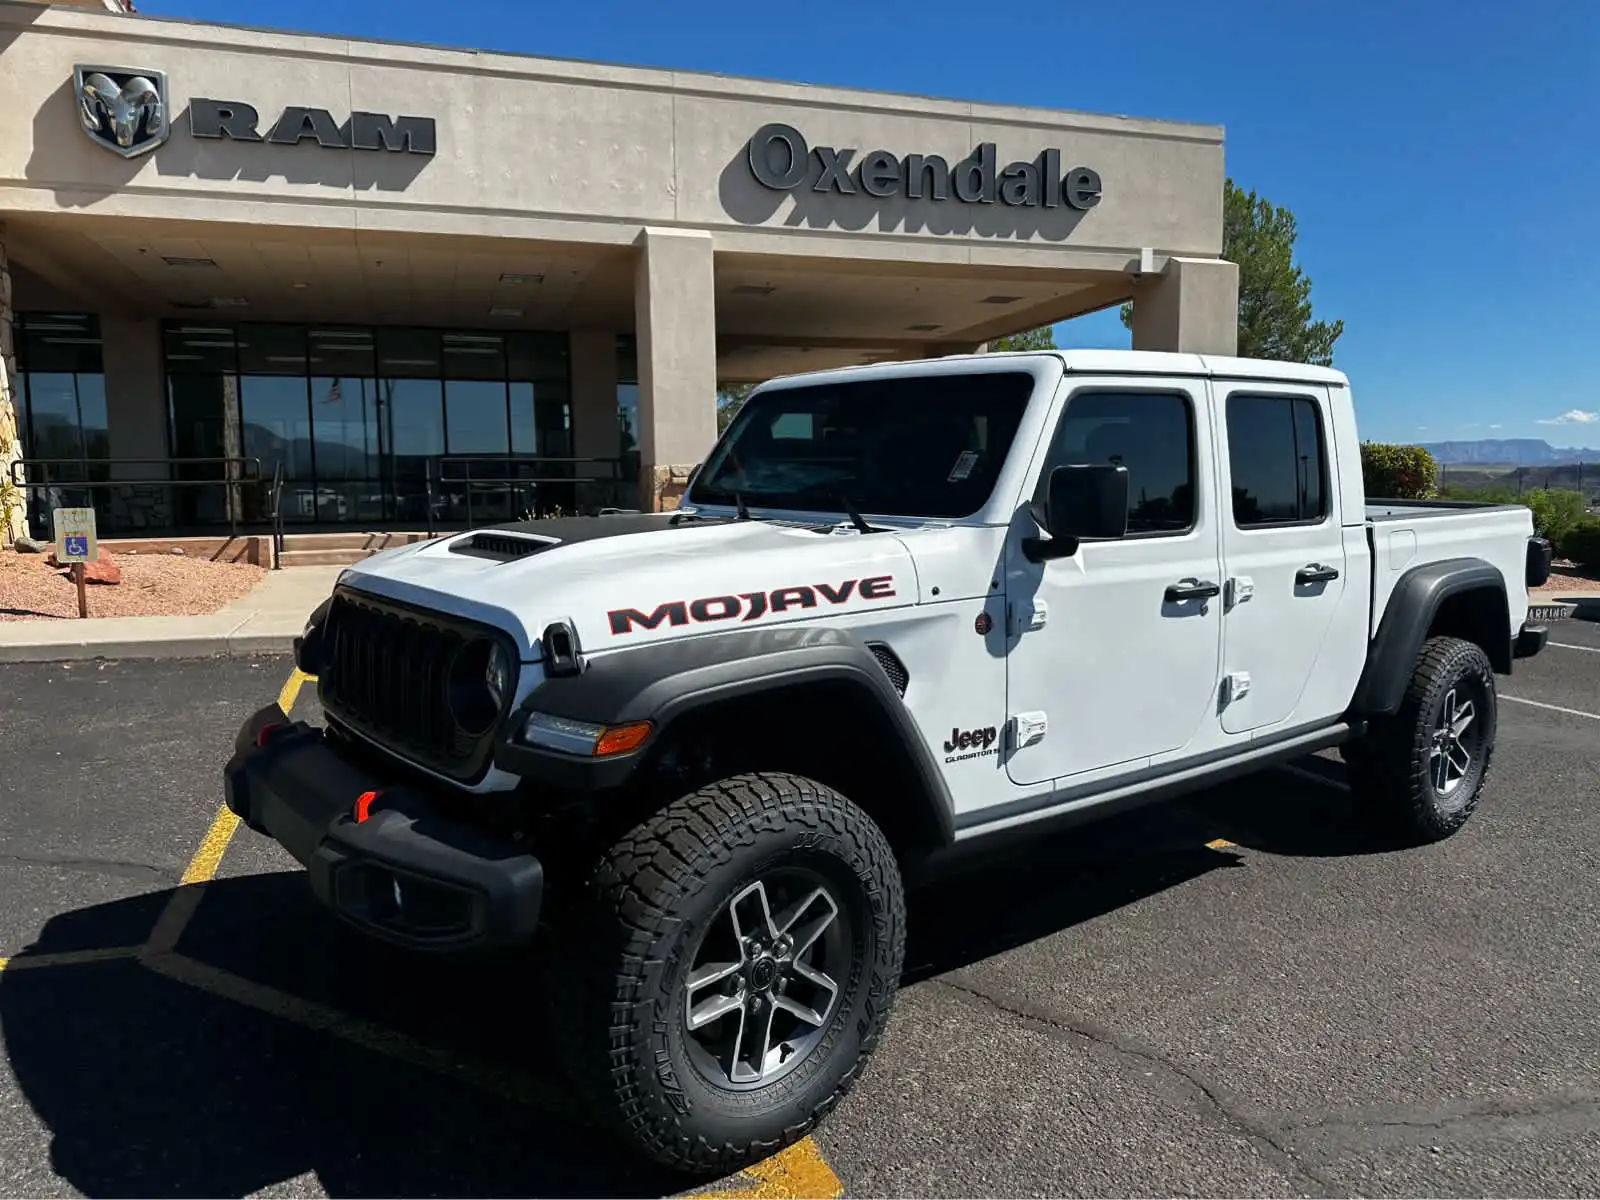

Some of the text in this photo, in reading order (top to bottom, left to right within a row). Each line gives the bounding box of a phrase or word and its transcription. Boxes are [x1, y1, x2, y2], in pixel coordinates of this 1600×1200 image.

[190, 98, 436, 155] RAM
[748, 123, 1103, 210] Oxendale
[607, 575, 896, 635] MOJAVE
[944, 726, 996, 753] Jeep
[945, 749, 992, 763] GLADIATOR
